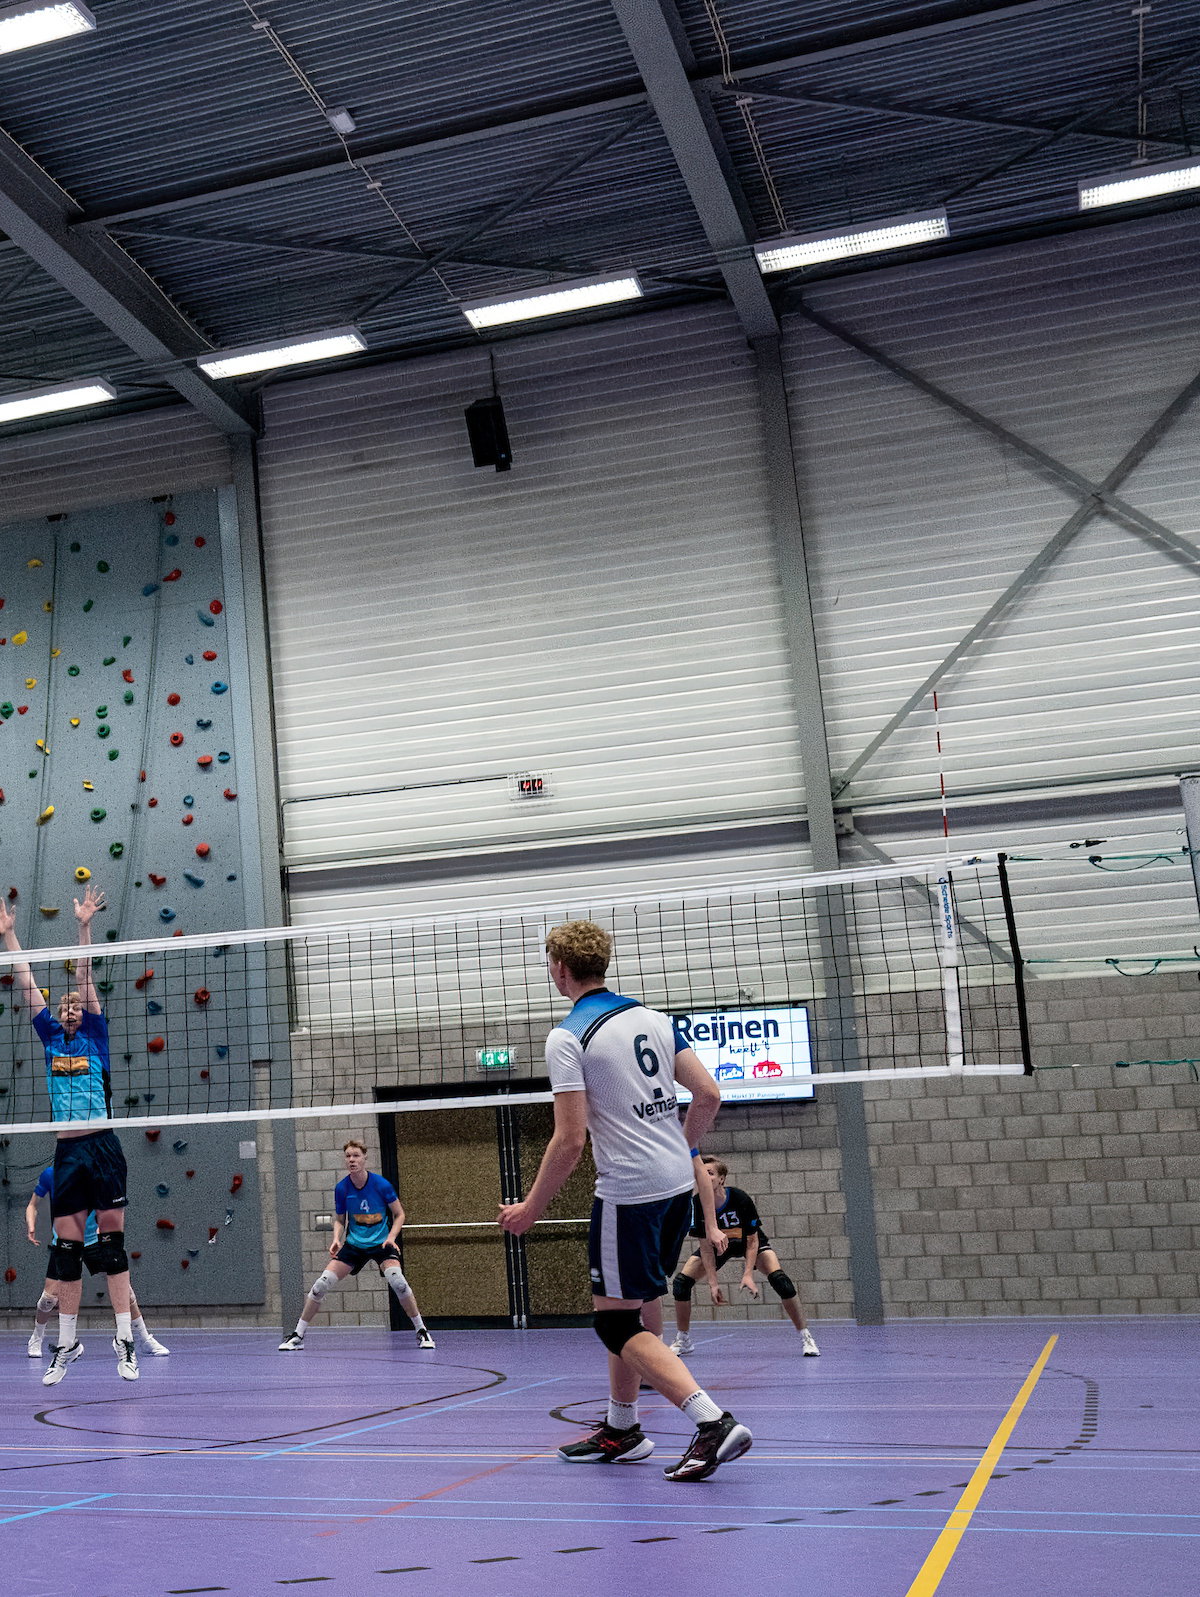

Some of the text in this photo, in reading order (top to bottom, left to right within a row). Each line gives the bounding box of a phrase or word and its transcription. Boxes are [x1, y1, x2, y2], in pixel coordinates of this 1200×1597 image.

[673, 1014, 779, 1048] Reijnen
[634, 1033, 660, 1078] 6
[360, 1199, 370, 1213] 4
[719, 1210, 740, 1228] 13
